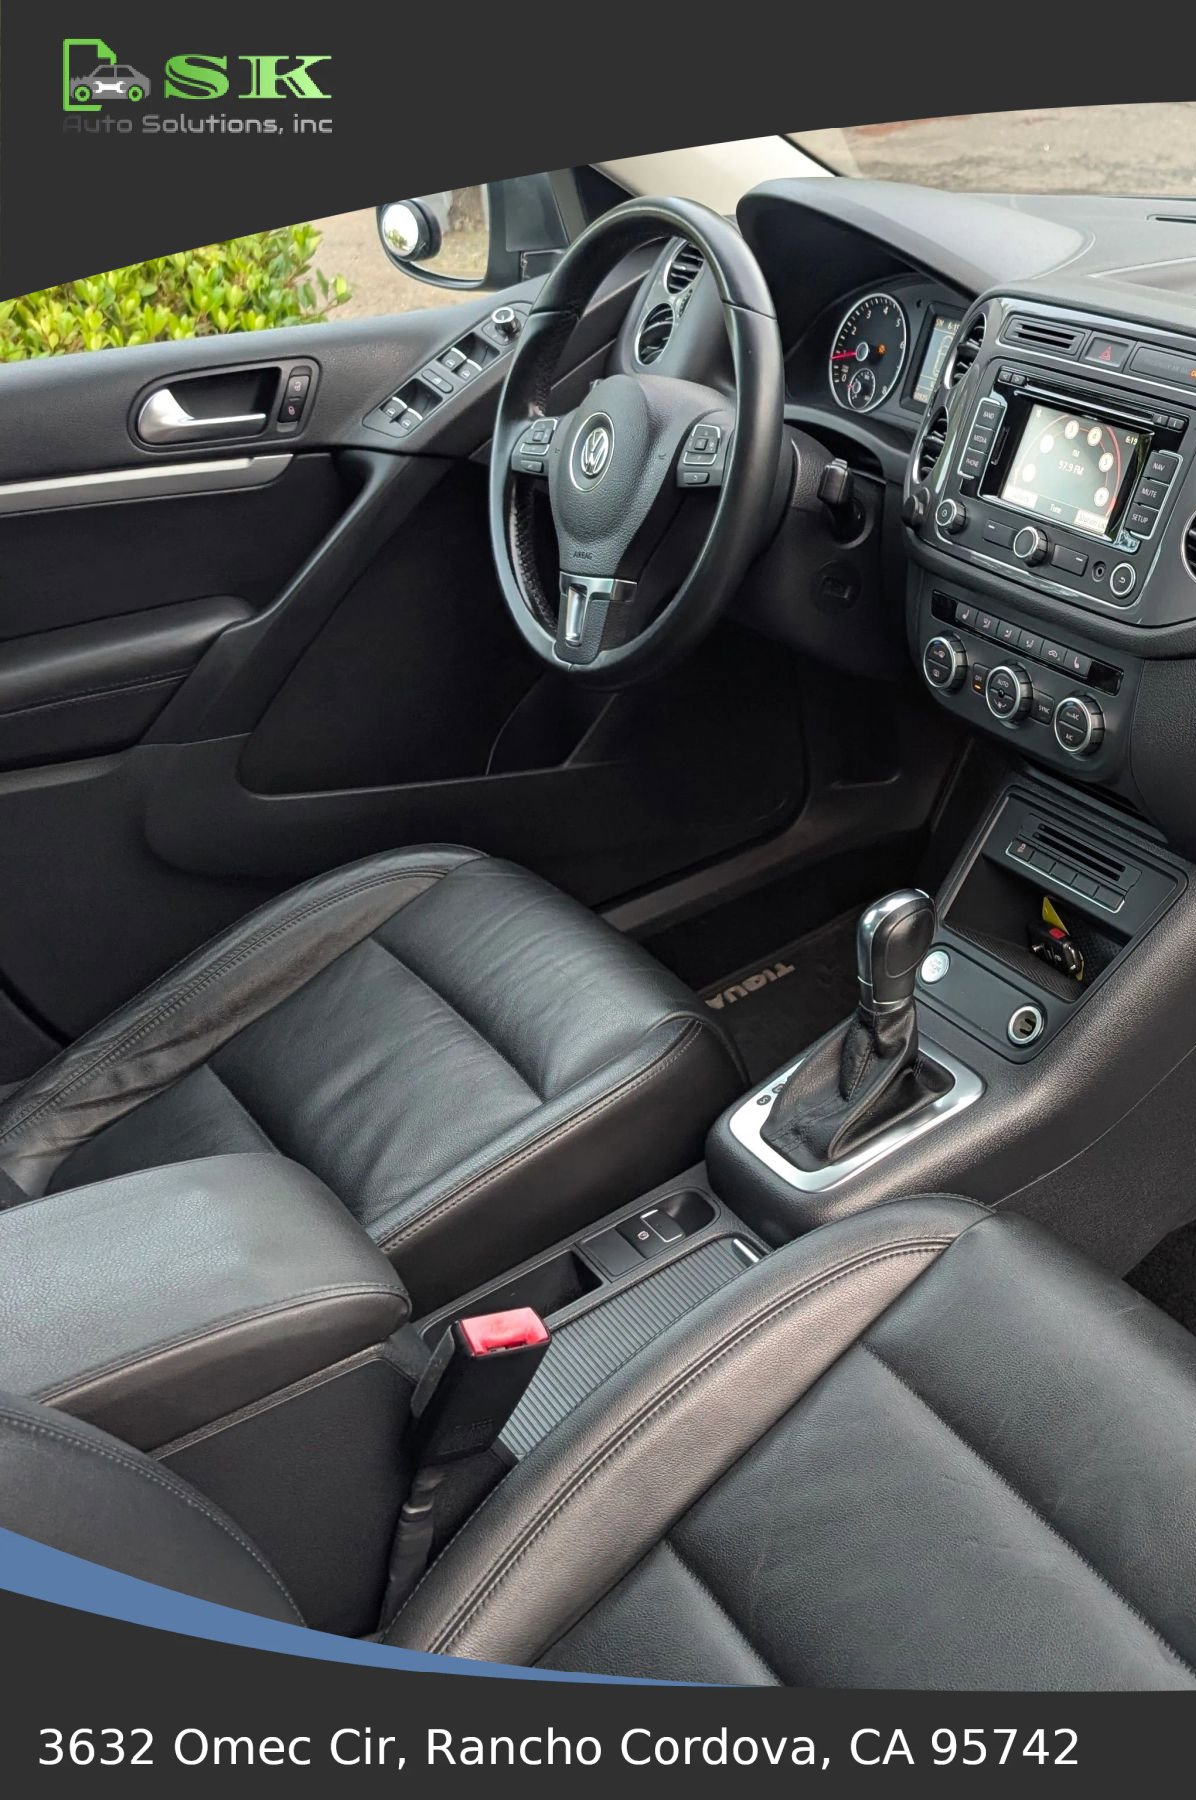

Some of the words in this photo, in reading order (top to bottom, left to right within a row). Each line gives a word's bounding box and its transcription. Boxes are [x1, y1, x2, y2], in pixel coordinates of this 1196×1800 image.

[983, 410, 995, 420] BAND
[973, 433, 987, 444] MEDIA
[965, 458, 979, 468] PHONE
[1152, 462, 1165, 472] NAV
[1141, 487, 1158, 499] MUTE
[1131, 513, 1149, 524] SETUP
[997, 678, 1009, 688] AUTO
[1038, 704, 1051, 714] SYNC
